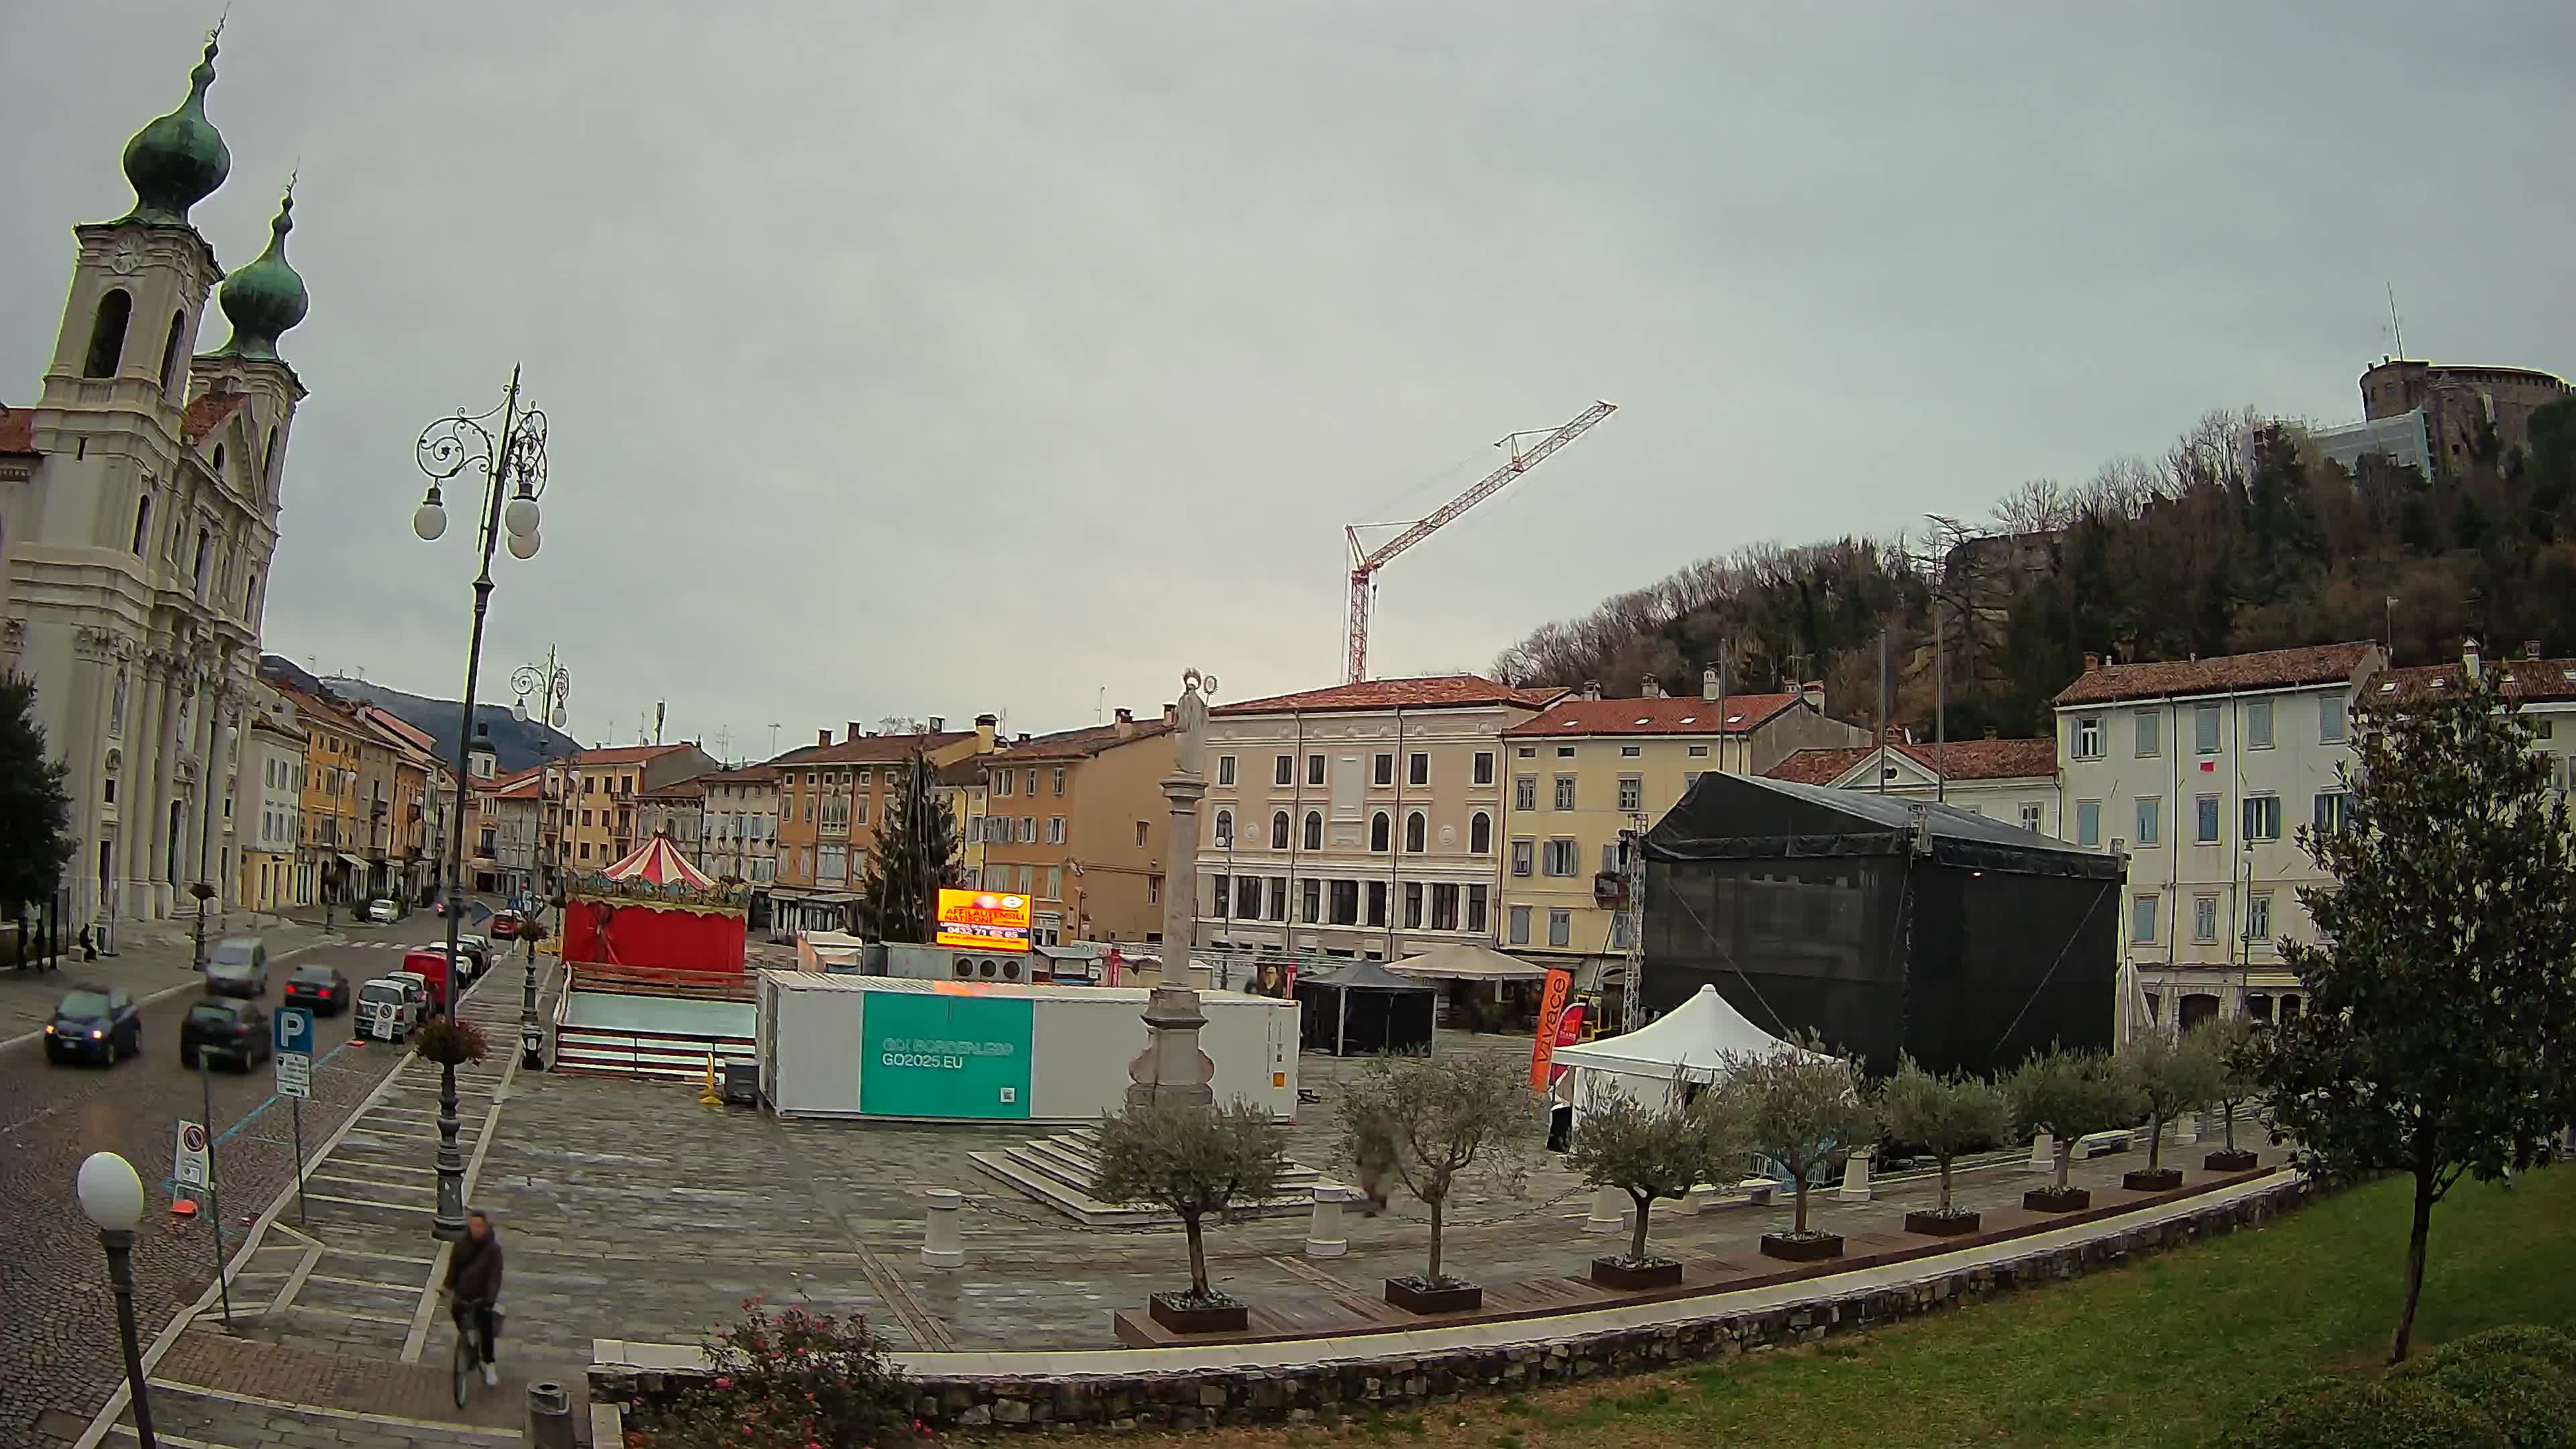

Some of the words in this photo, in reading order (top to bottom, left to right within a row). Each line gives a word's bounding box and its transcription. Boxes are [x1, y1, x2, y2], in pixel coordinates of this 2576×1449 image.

[947, 926, 973, 935] 0432
[974, 928, 987, 936] 71
[280, 1012, 305, 1047] P
[882, 1053, 963, 1069] GO2025.EU
